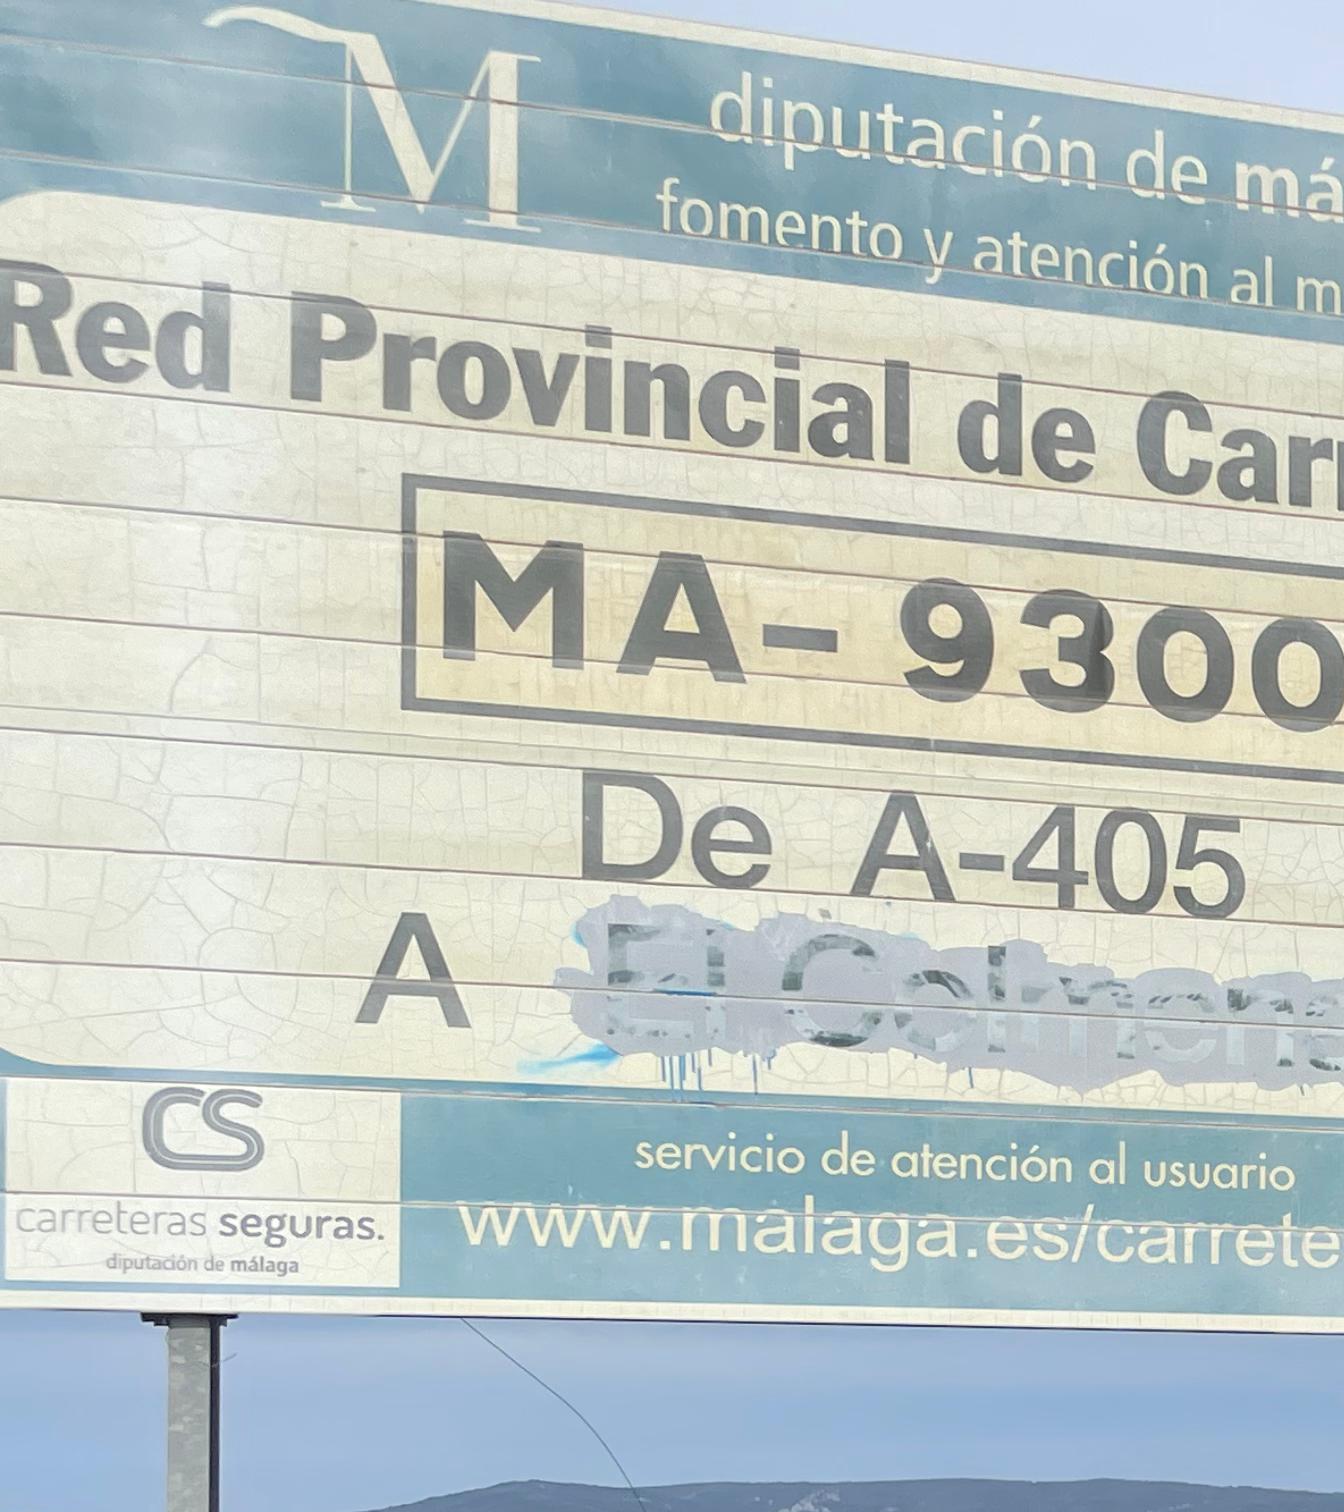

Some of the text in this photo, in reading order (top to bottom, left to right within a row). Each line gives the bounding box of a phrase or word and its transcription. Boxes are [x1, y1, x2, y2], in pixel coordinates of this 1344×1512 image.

[711, 72, 1097, 191] diputación
[1125, 130, 1207, 206] de
[656, 178, 903, 260] fomento
[925, 229, 953, 284] y
[974, 232, 1208, 300] atención
[1230, 257, 1273, 308] al
[0, 259, 231, 393] Red
[290, 291, 911, 464] Provincial
[956, 374, 1095, 484] de
[581, 771, 1245, 919] De A-405
[355, 912, 470, 1028] A
[143, 1087, 264, 1171] CS
[634, 1130, 1296, 1192] servicio de atención al usuario
[16, 1200, 385, 1248] carreteras seguras.
[106, 1253, 299, 1277] diputación de málaga
